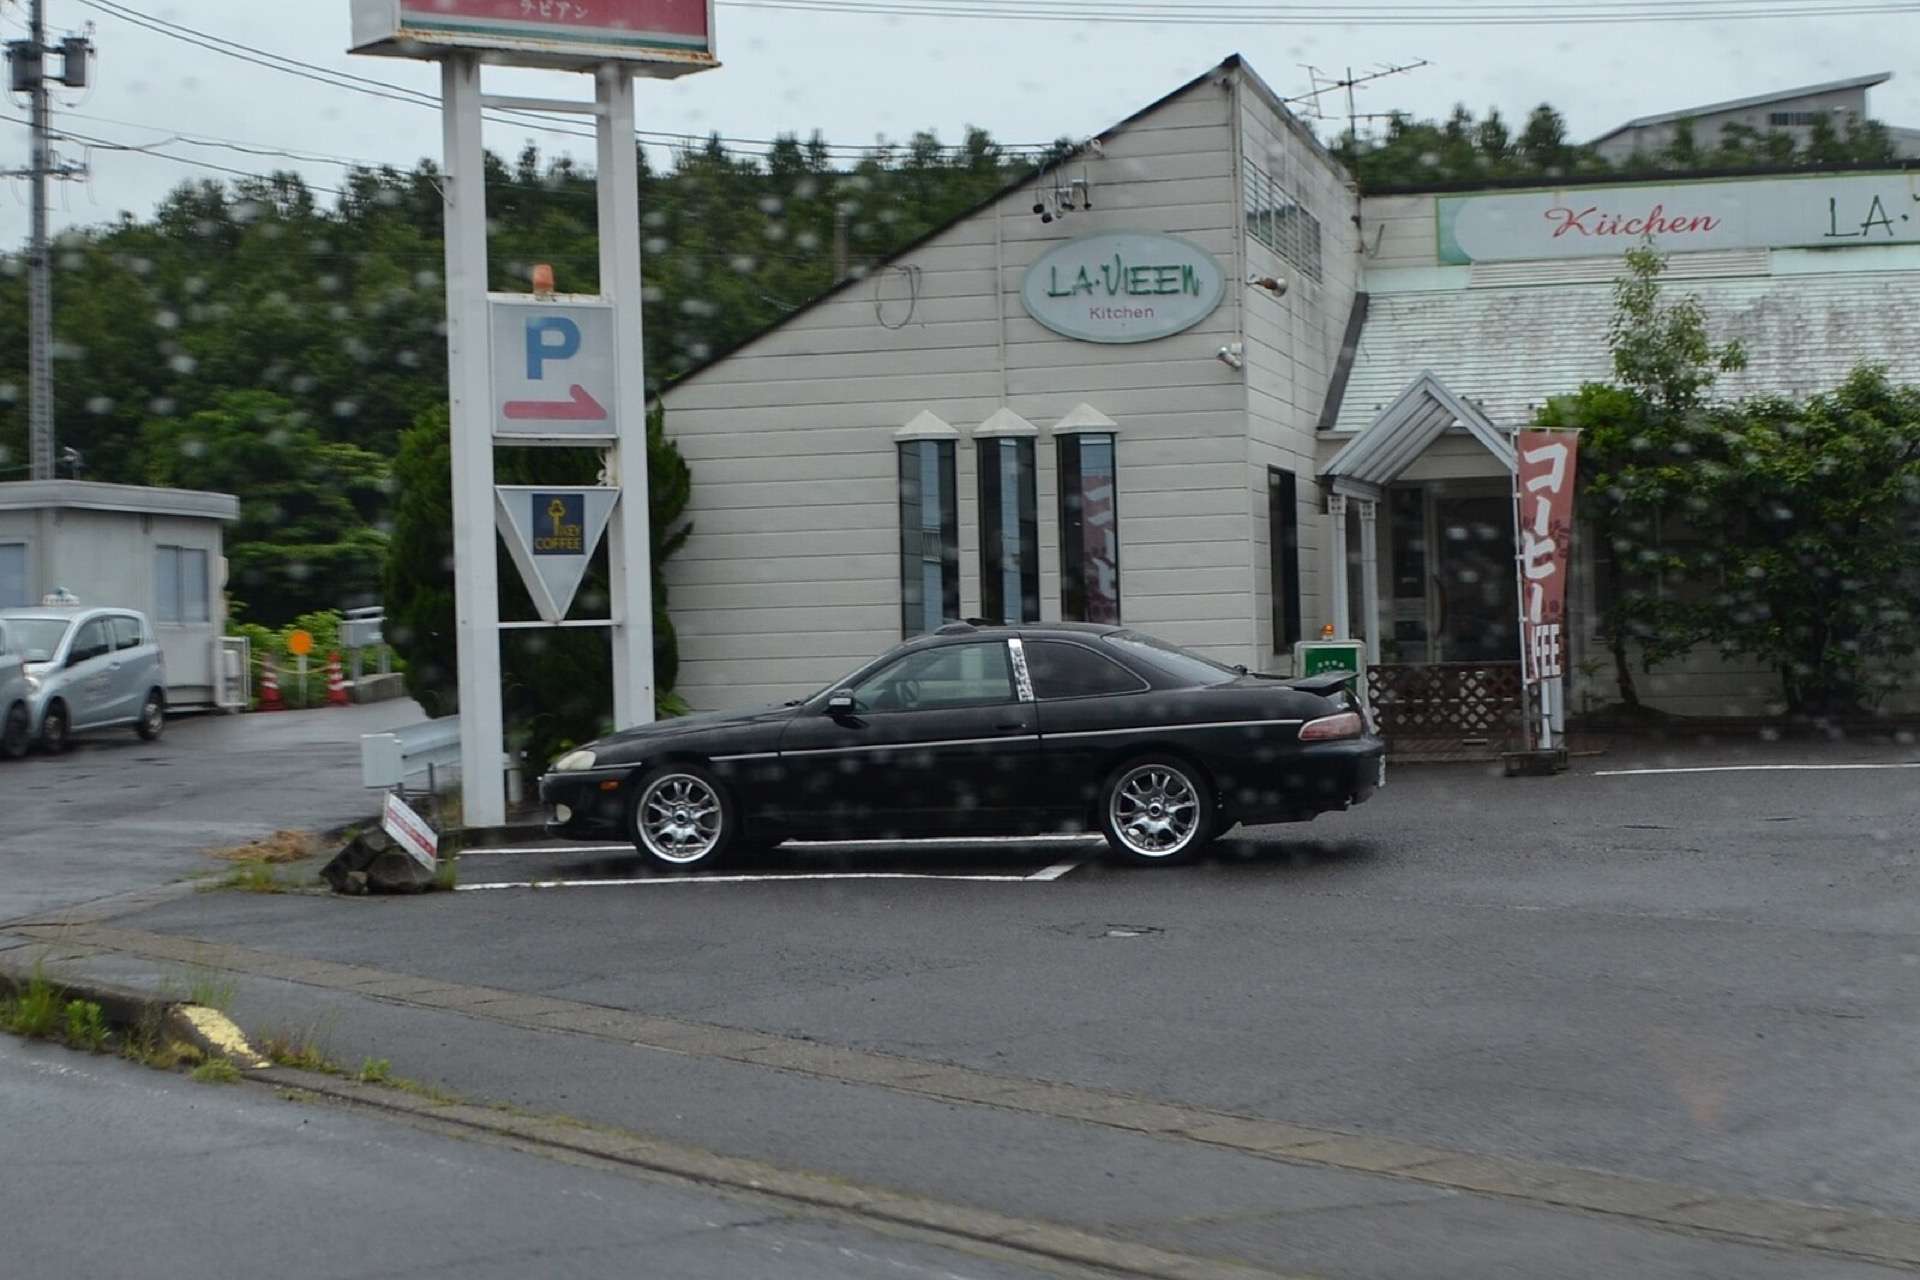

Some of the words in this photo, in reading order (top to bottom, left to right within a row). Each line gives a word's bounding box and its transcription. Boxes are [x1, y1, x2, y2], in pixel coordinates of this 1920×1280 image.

[1089, 306, 1155, 320] Kitchen
[526, 316, 581, 380] P
[535, 537, 581, 550] COFFEE
